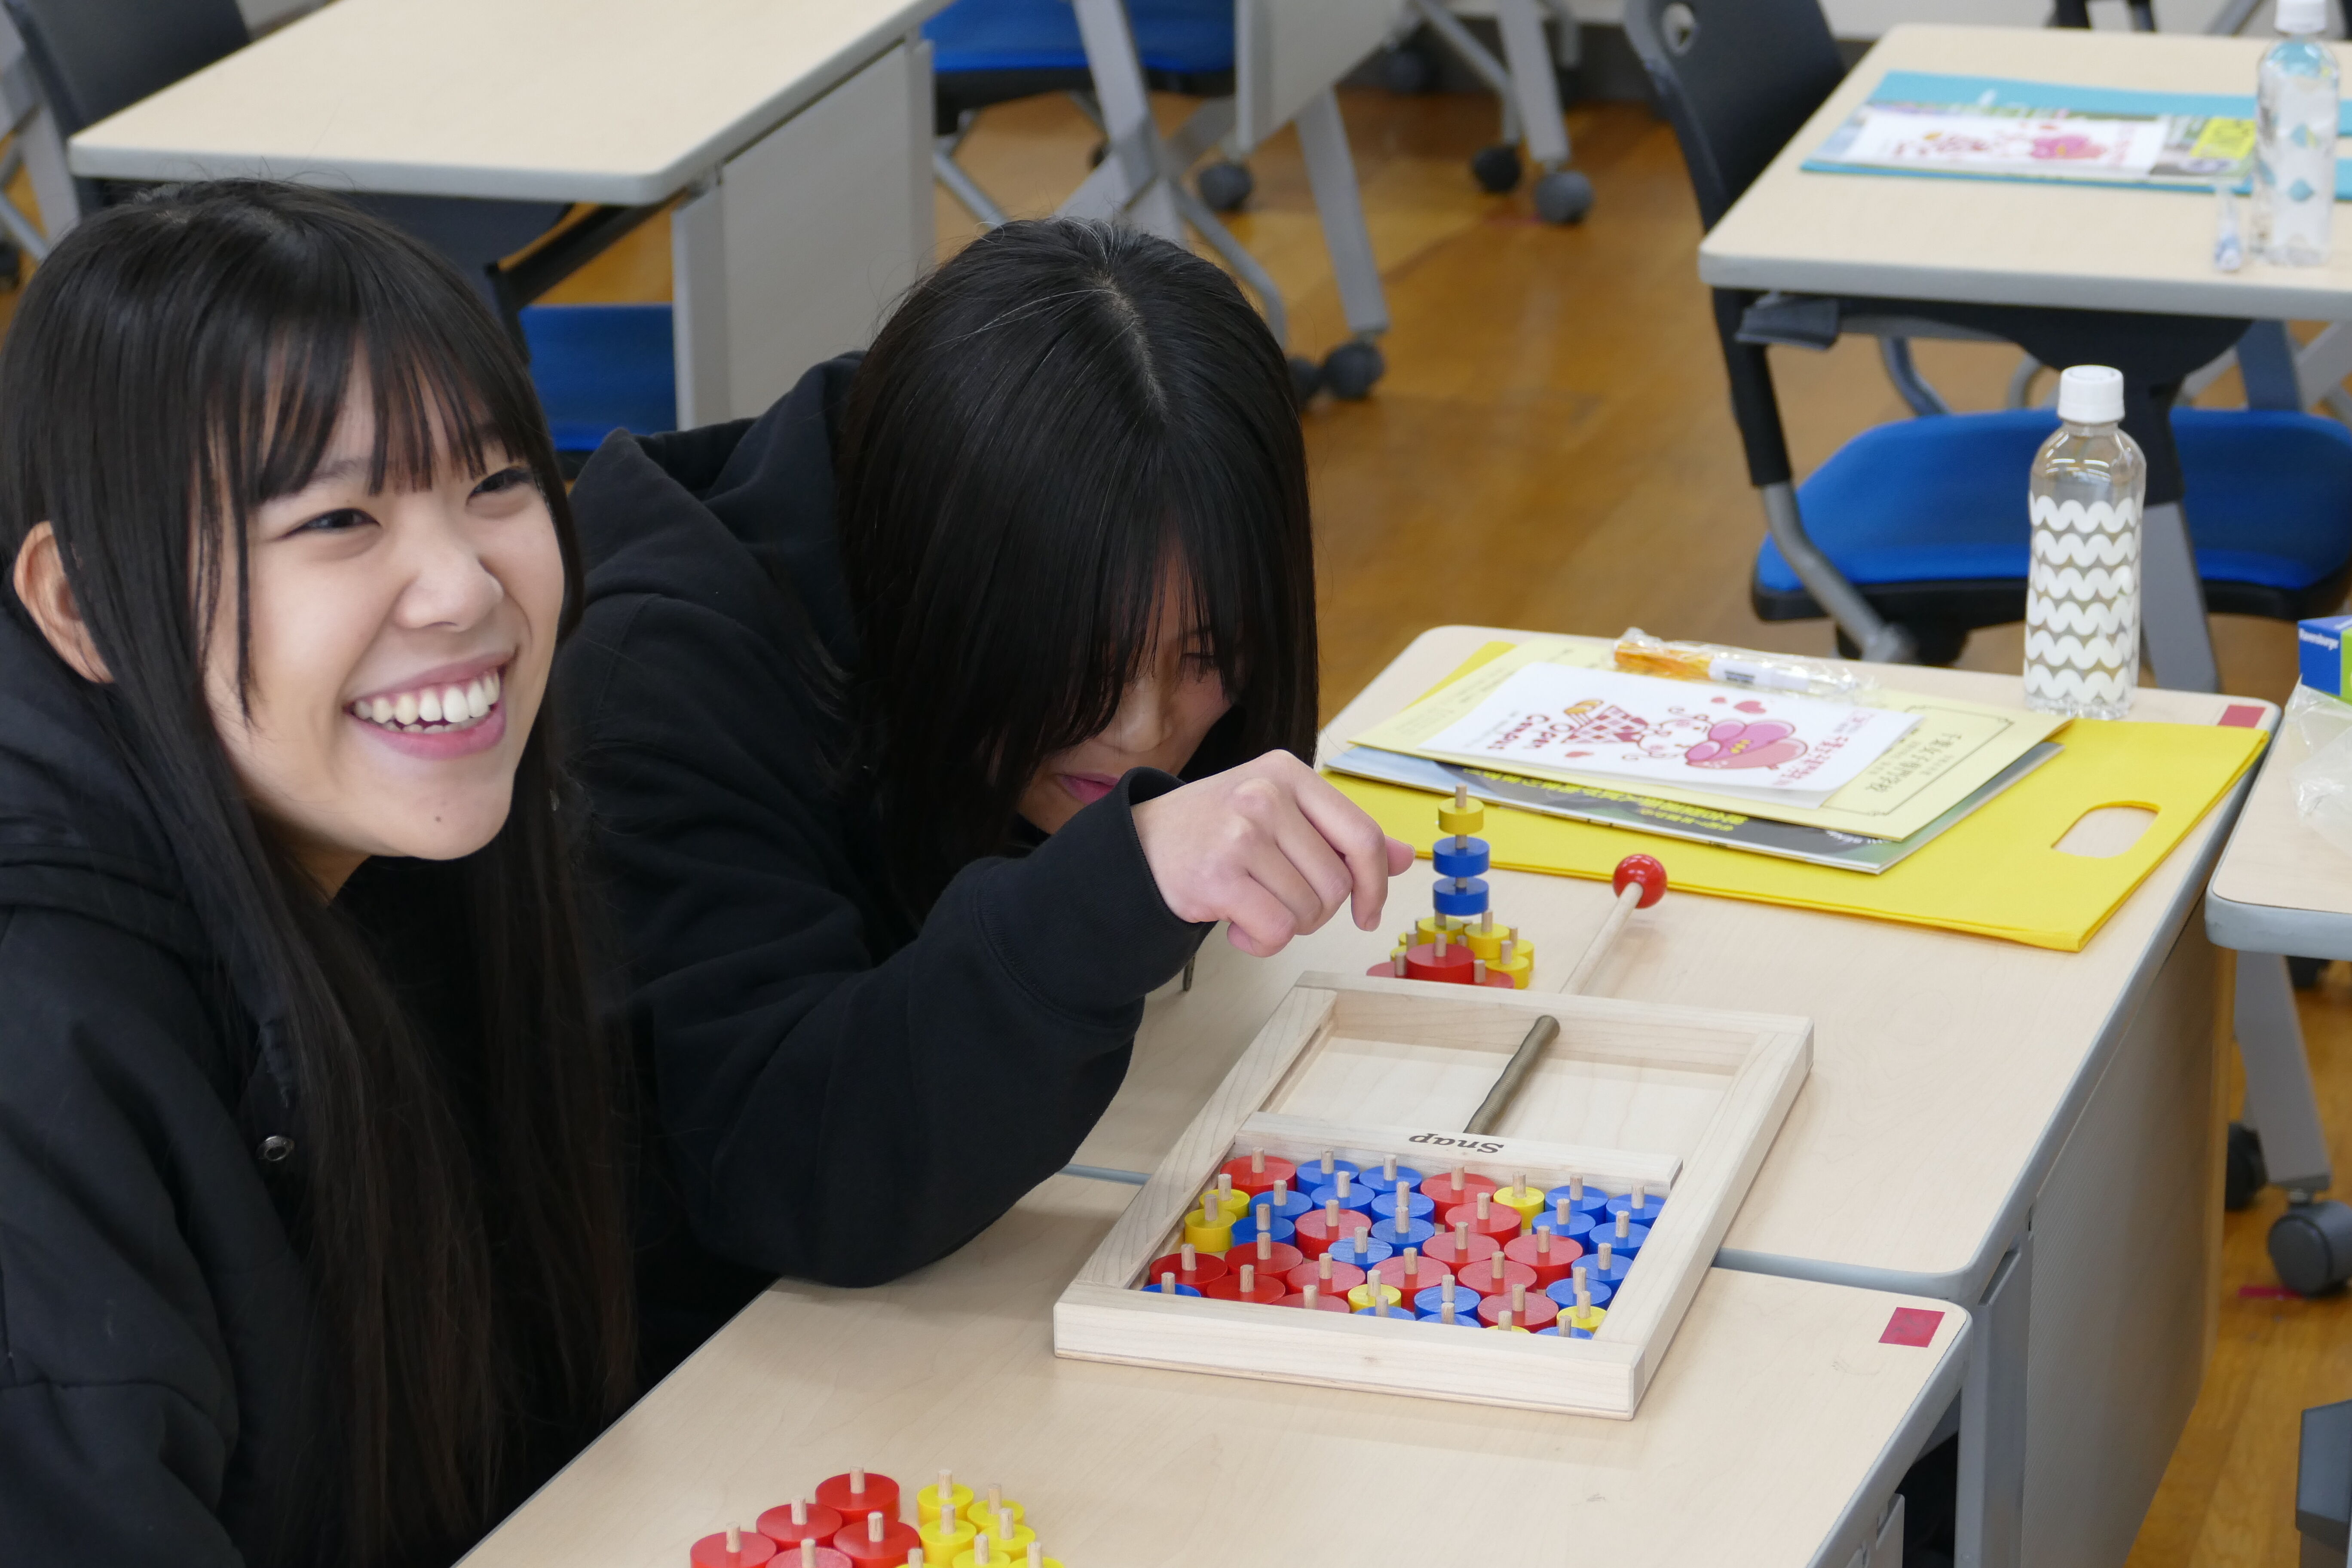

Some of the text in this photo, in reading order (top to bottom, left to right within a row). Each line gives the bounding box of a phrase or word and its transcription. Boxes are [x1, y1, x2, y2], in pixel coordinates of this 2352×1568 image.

[1486, 714, 1550, 750] Campus
[1523, 723, 1576, 749] Open
[1409, 1133, 1504, 1154] Snap
